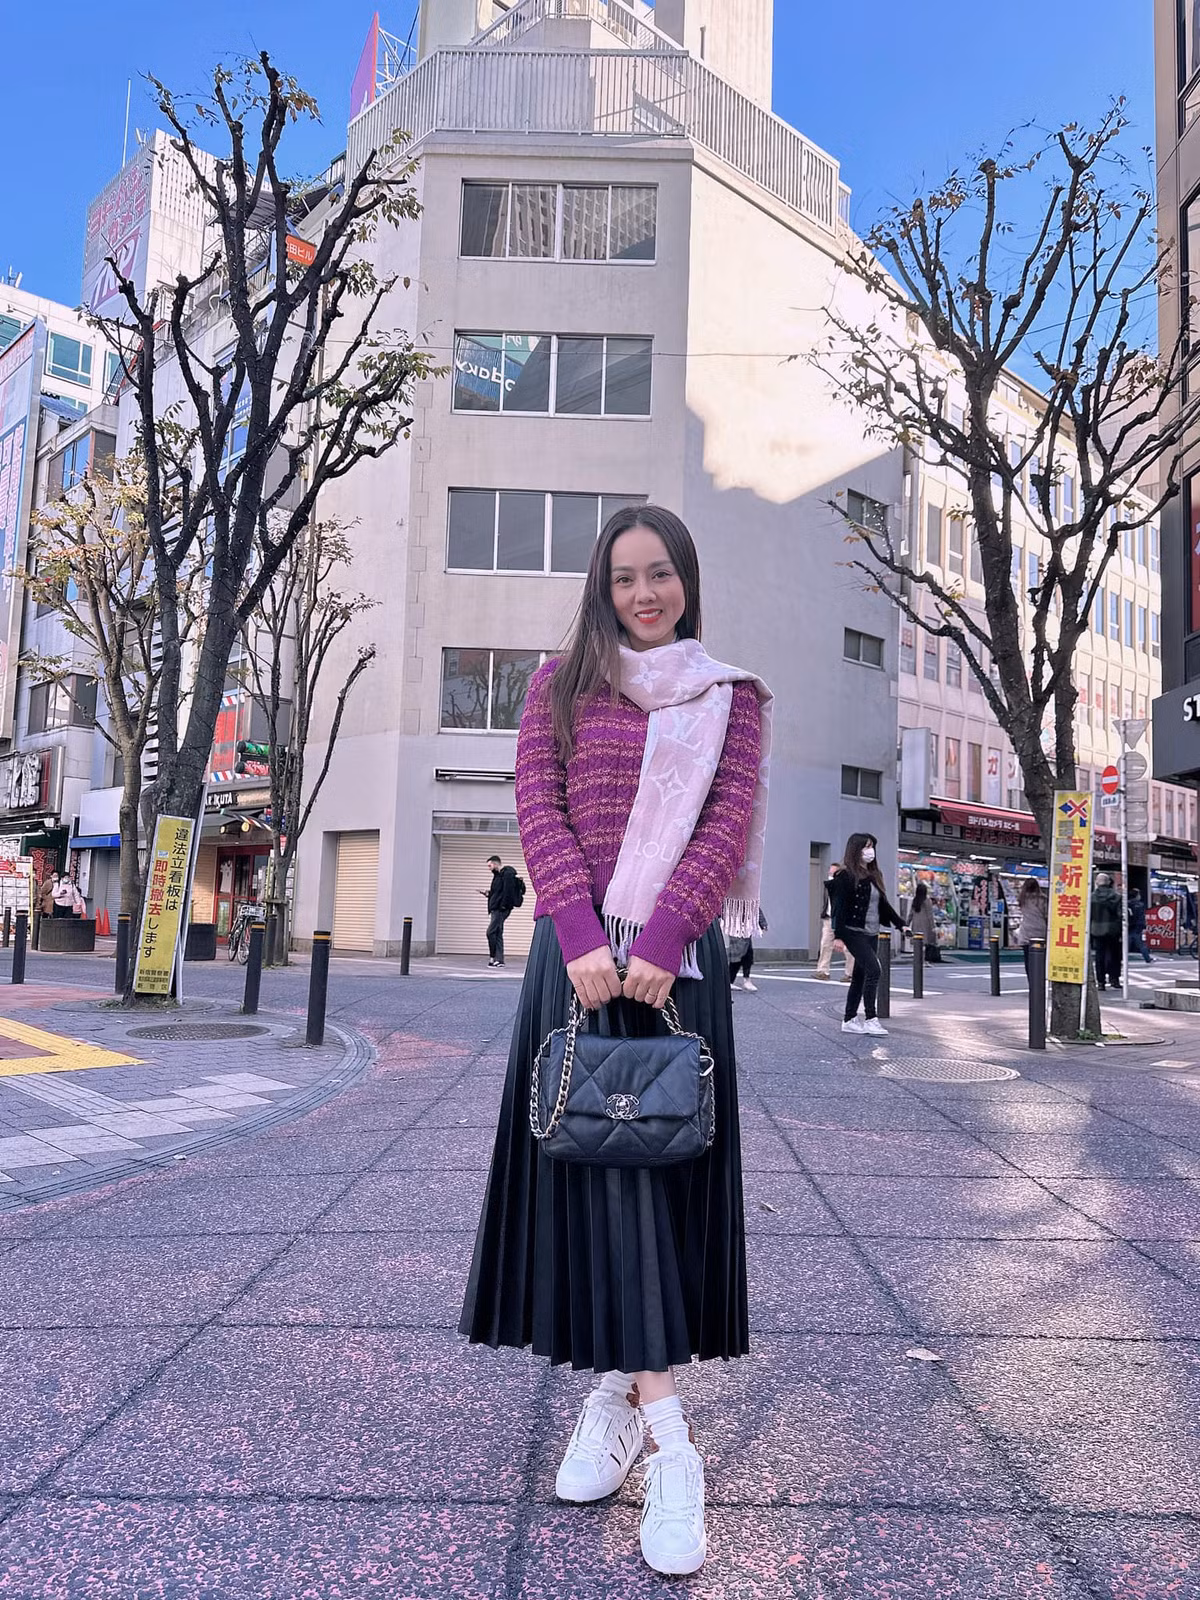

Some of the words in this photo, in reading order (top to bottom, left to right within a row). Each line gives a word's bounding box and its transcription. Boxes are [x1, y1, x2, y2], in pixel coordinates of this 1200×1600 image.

[143, 859, 169, 959] 即時撤去します
[165, 827, 188, 911] 違法立看板は
